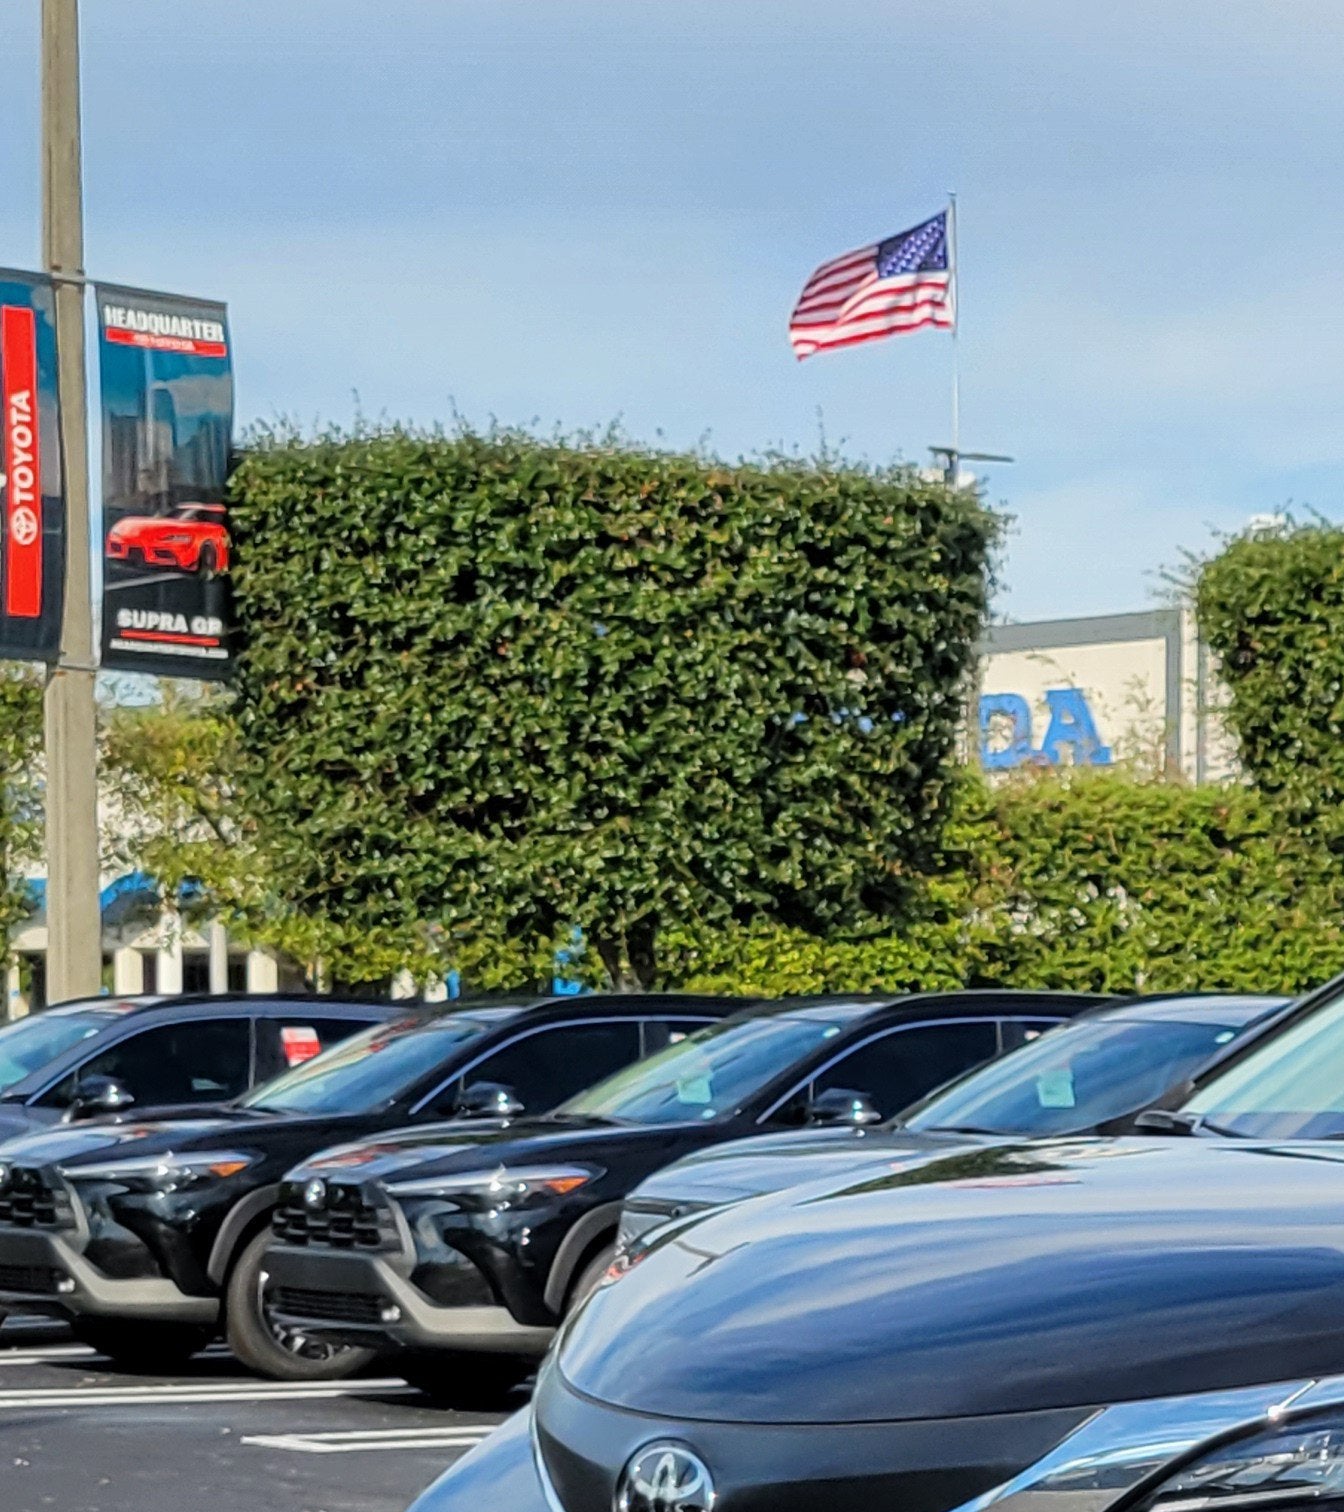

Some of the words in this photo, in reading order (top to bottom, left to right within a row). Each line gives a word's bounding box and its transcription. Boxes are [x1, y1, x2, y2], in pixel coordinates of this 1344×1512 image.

[104, 304, 225, 343] HEADQUARTER
[10, 388, 35, 506] TOYOTA
[117, 607, 189, 633] SUPRA
